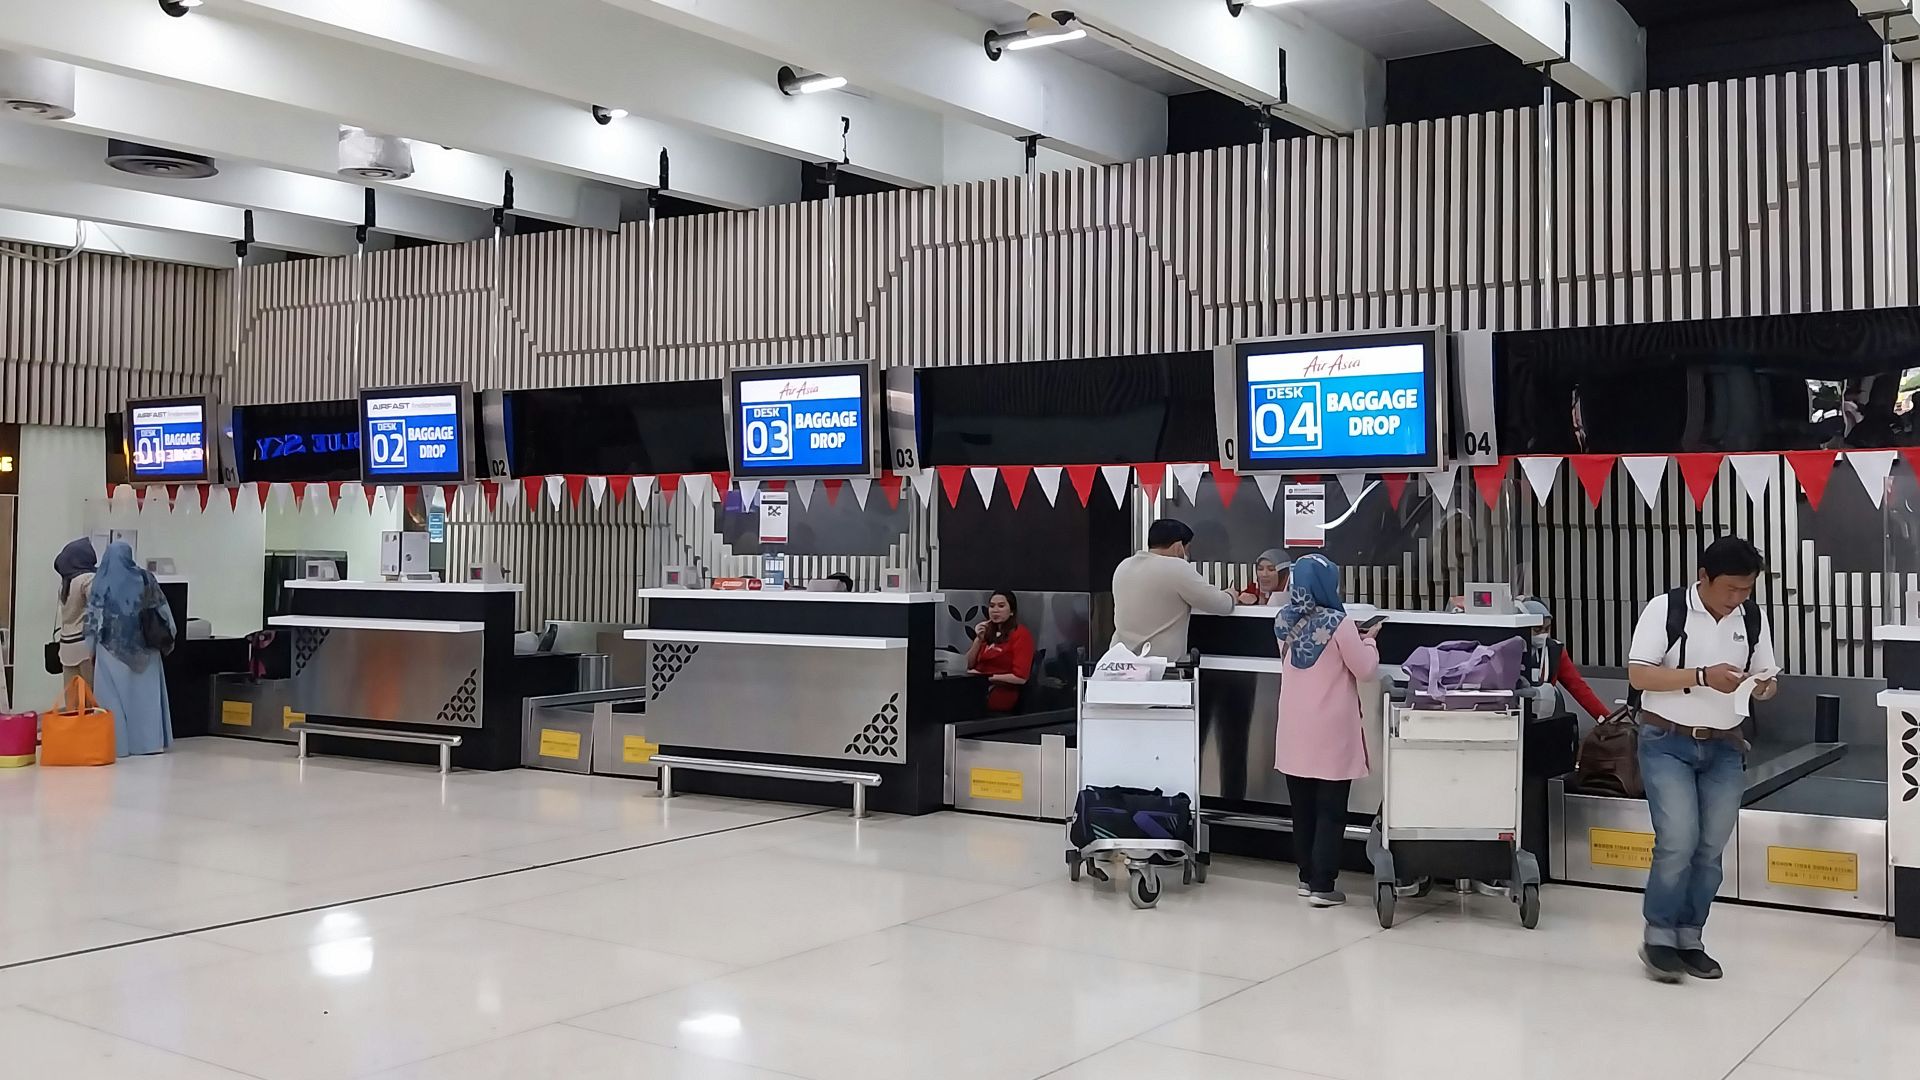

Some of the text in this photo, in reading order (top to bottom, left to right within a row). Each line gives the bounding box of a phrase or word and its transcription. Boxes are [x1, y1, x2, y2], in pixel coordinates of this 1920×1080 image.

[1266, 386, 1304, 400] DESK
[1326, 389, 1418, 412] BAGGAGE
[372, 402, 410, 410] AIRFAST
[753, 407, 780, 418] DESK
[377, 422, 397, 431] DESK
[795, 411, 858, 429] BAGGAGE
[1255, 402, 1319, 444] 04
[1348, 415, 1401, 436] DROP
[164, 432, 201, 446] BAGGAGE
[407, 426, 455, 441] BAGGAGE
[747, 420, 789, 455] 03
[810, 432, 846, 449] DROP
[138, 437, 160, 465] 01
[373, 433, 405, 463] 02
[419, 444, 446, 459] DROP
[1225, 439, 1234, 461] 0
[1464, 431, 1491, 455] 04
[896, 448, 915, 468] 03
[225, 467, 236, 482] 01
[492, 460, 507, 477] 02
